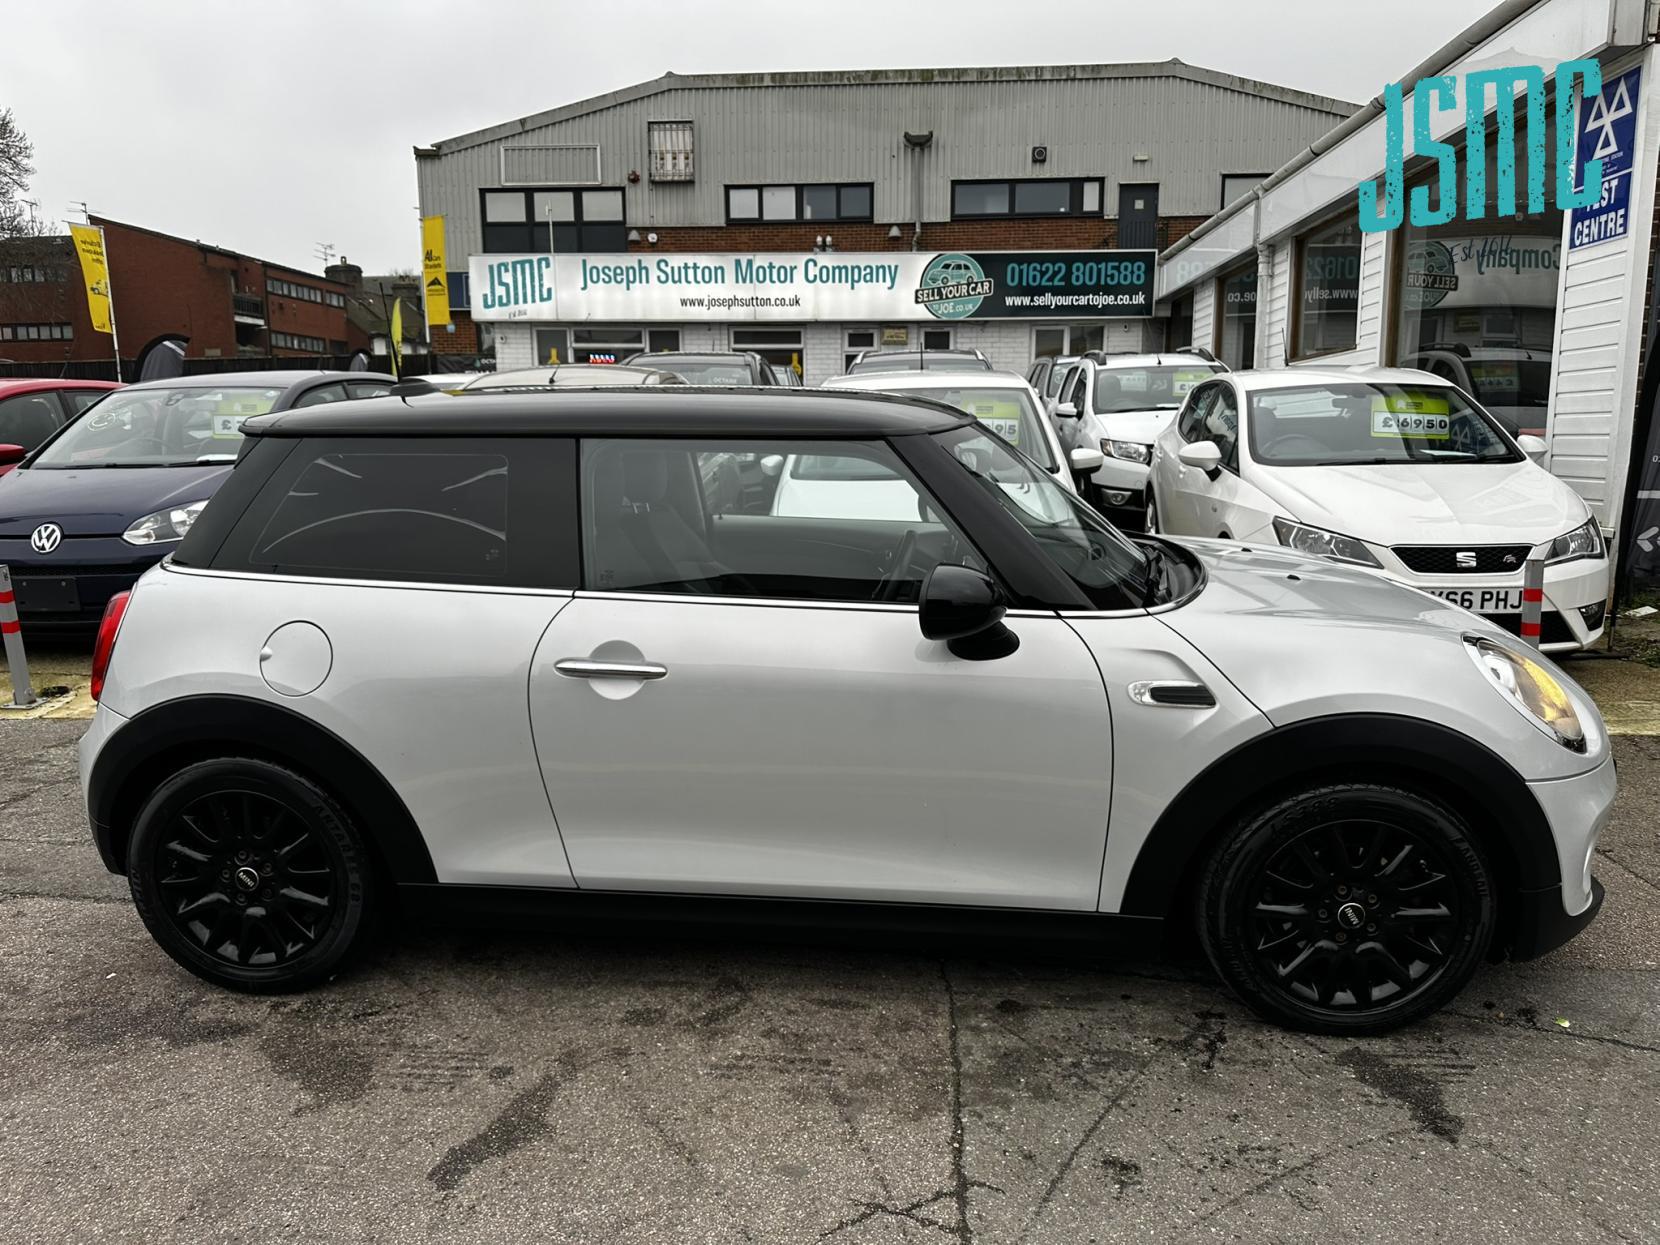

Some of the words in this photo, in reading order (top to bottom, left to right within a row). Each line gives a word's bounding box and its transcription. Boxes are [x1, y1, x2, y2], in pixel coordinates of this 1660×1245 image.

[1574, 208, 1625, 246] CENTRE
[482, 256, 553, 310] JSMC
[580, 258, 650, 291] Joseph
[656, 258, 726, 284] Sutton
[734, 258, 798, 284] Motor
[803, 257, 899, 291] Company
[1006, 262, 1066, 286] 01622
[1071, 261, 1146, 285] 801588
[679, 294, 801, 311] www.josephsutton.co.uk
[917, 288, 940, 302] SELL
[941, 284, 968, 299] YOUR
[968, 281, 990, 296] CAR
[1004, 290, 1146, 309] www.sellyourcartojoe.co.uk
[1480, 590, 1523, 610] PHJ
